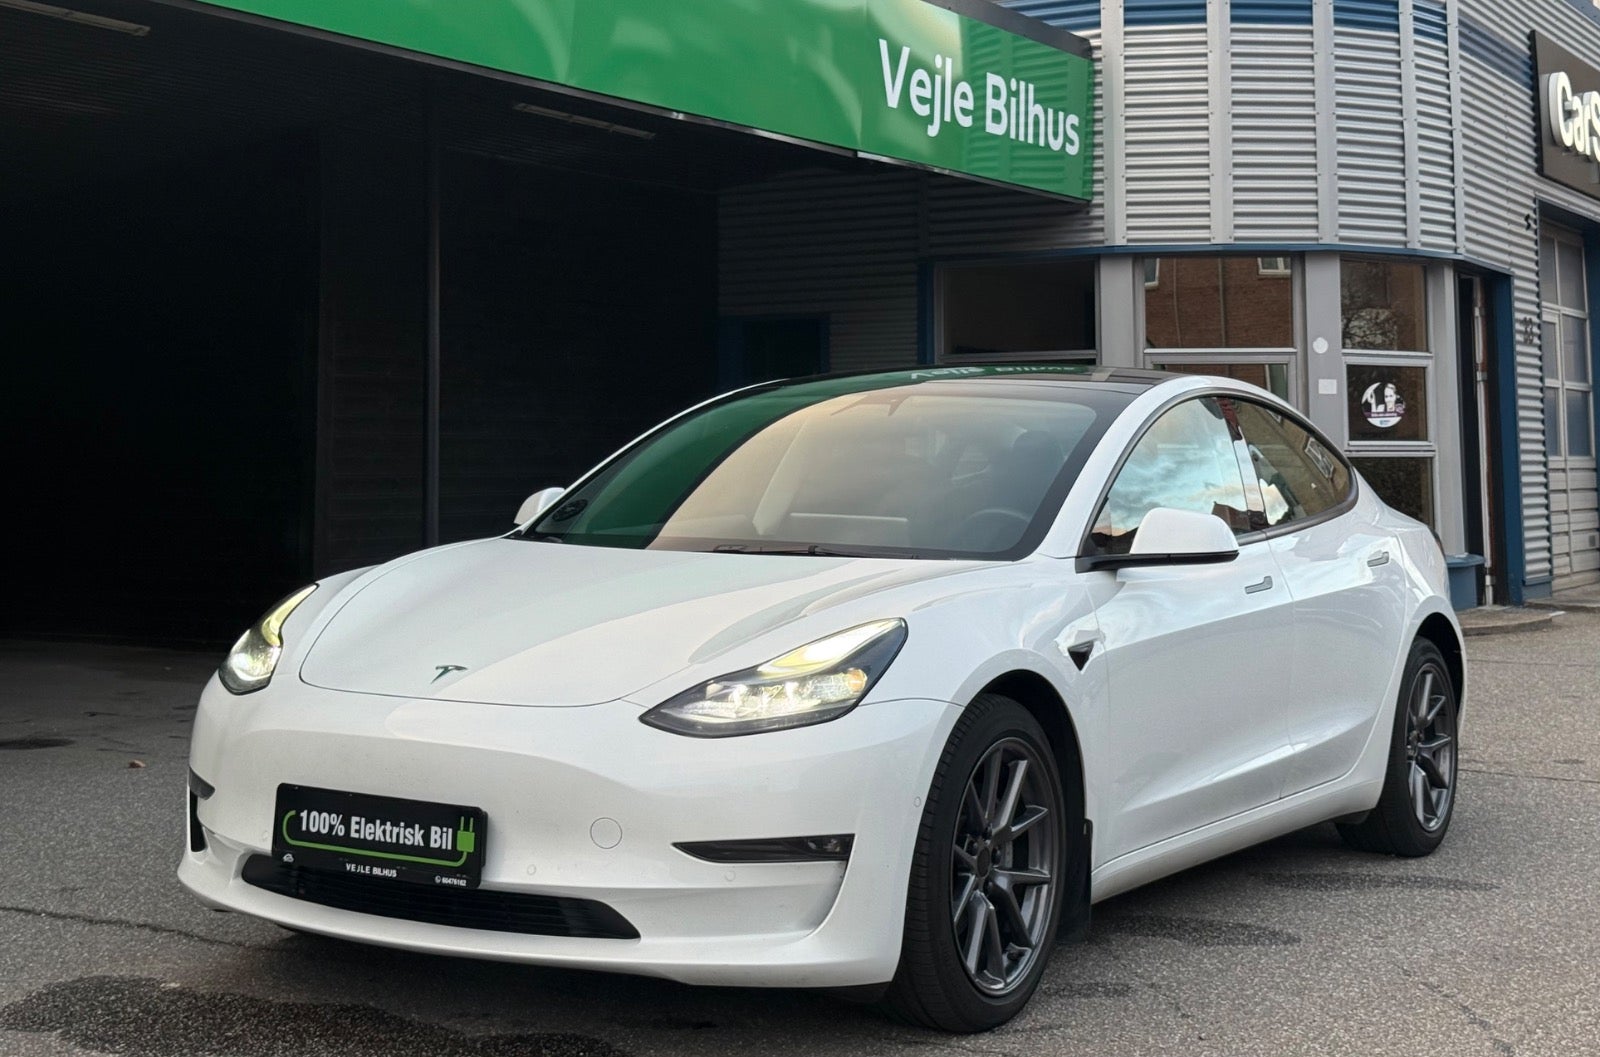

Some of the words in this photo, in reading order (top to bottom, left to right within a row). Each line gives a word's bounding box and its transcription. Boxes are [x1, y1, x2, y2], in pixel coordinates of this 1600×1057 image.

[879, 38, 974, 137] Vejle
[985, 72, 1080, 155] Bilhus
[300, 809, 346, 837] 100%
[350, 816, 425, 847] Elektrisk
[430, 825, 453, 850] Bil
[346, 863, 371, 874] VEJLE
[372, 866, 397, 878] BILHUS
